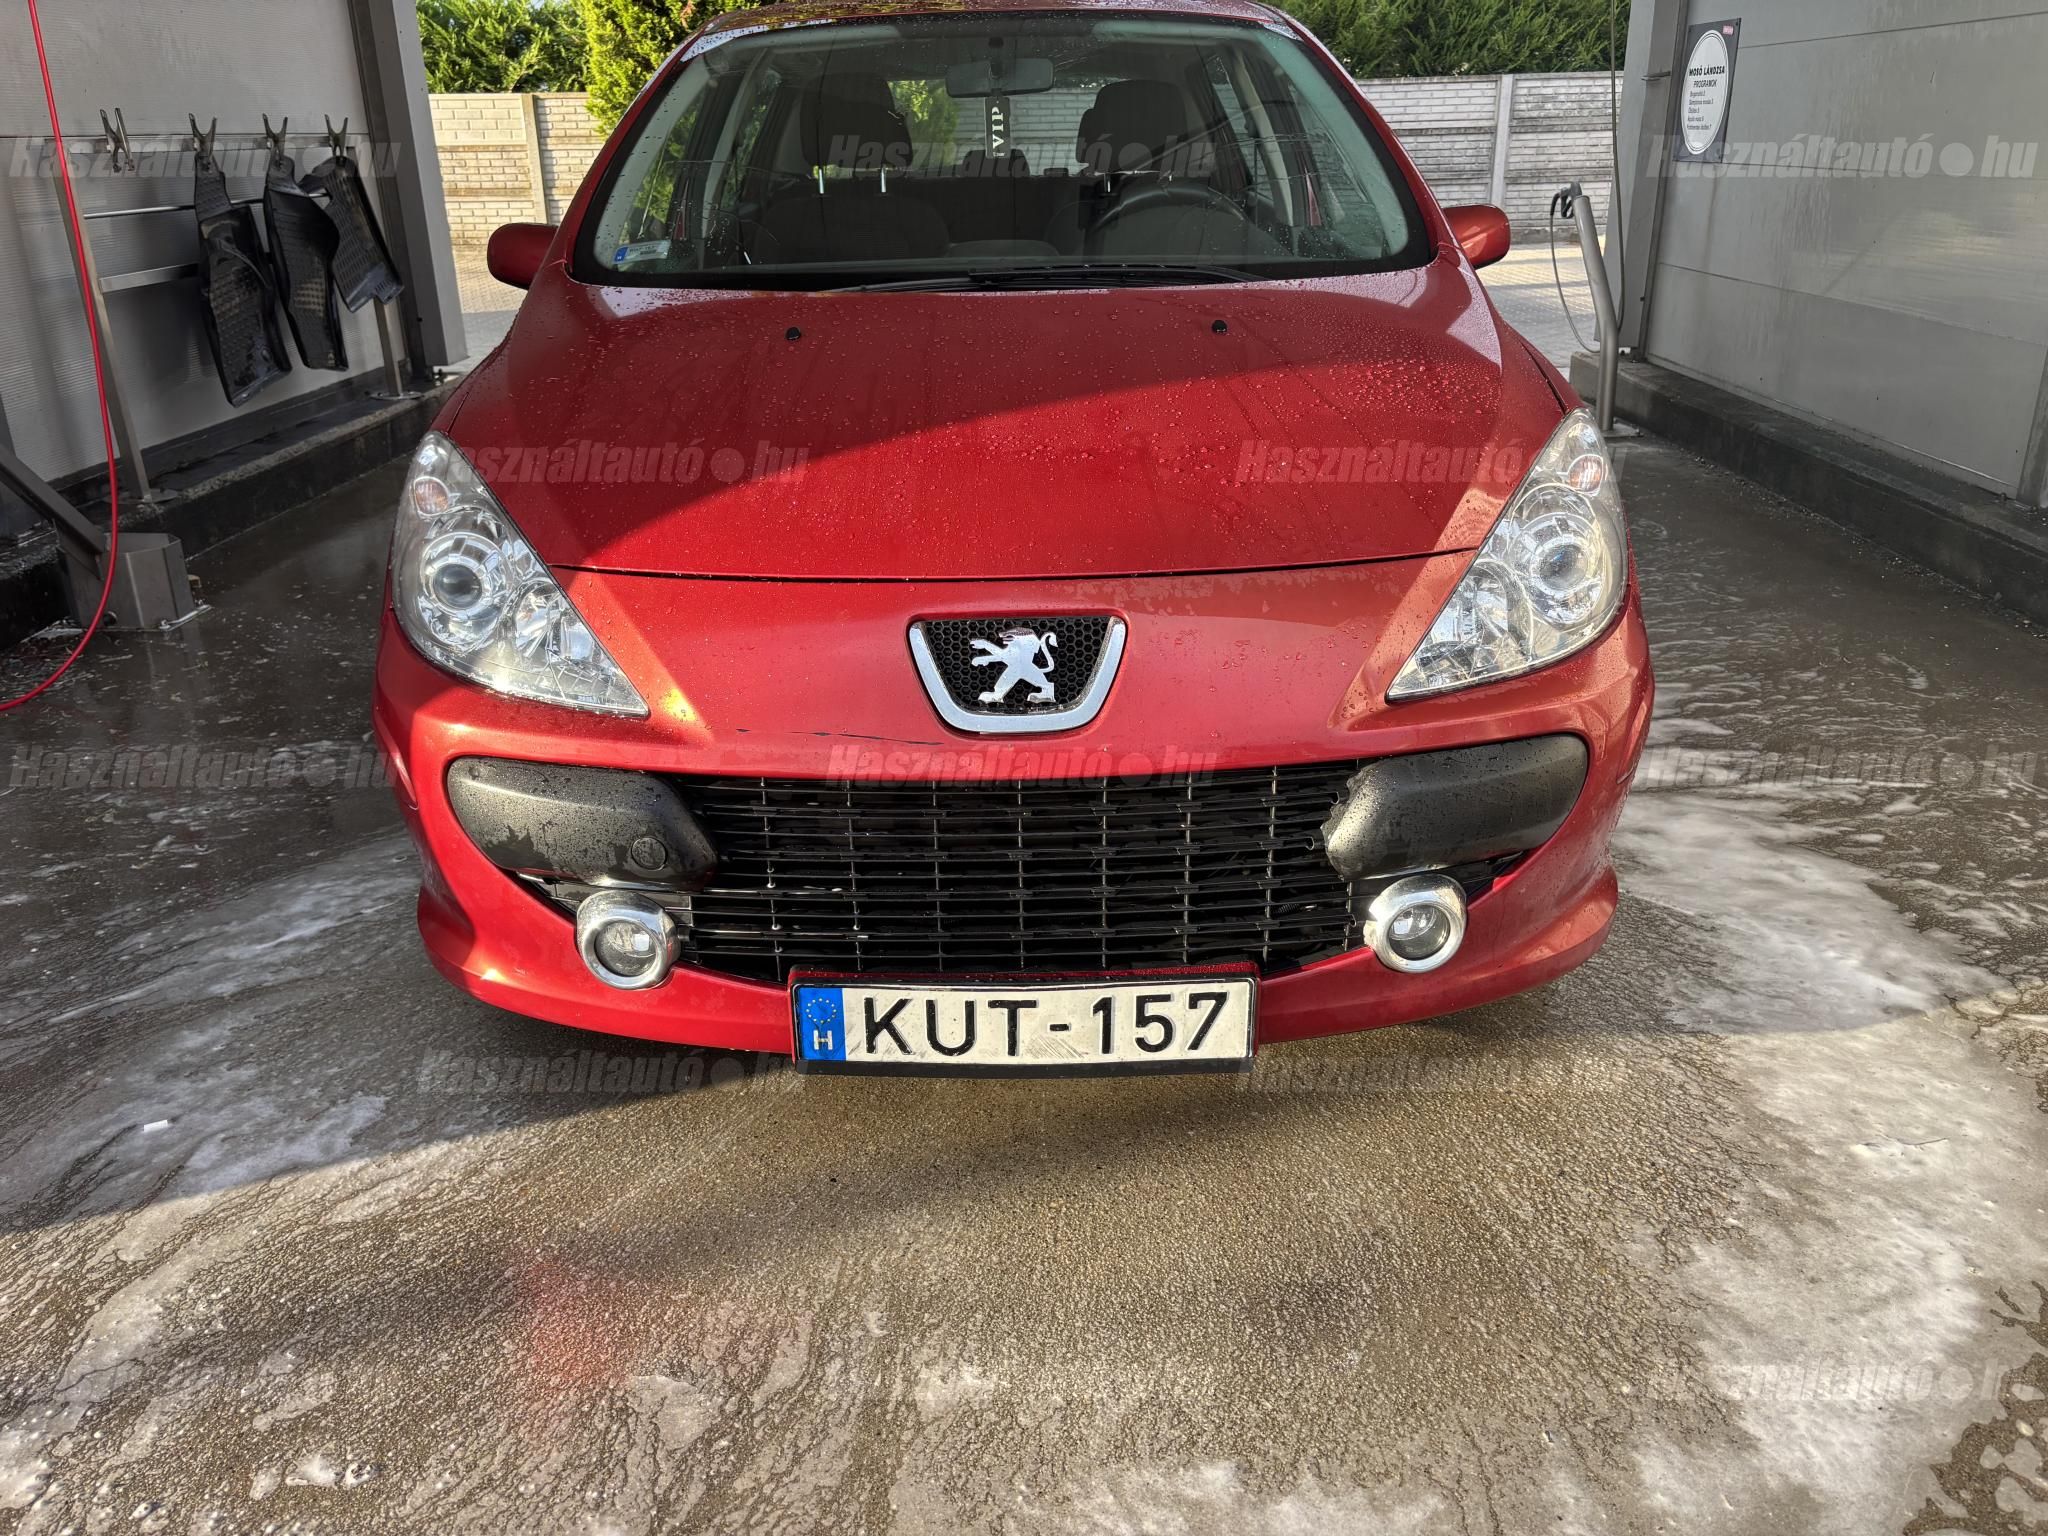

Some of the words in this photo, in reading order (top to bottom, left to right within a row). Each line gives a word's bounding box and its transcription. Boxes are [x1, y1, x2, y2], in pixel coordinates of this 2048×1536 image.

[992, 106, 1004, 149] VIP
[813, 1029, 834, 1051] H
[863, 990, 1229, 1057] KUT-157
